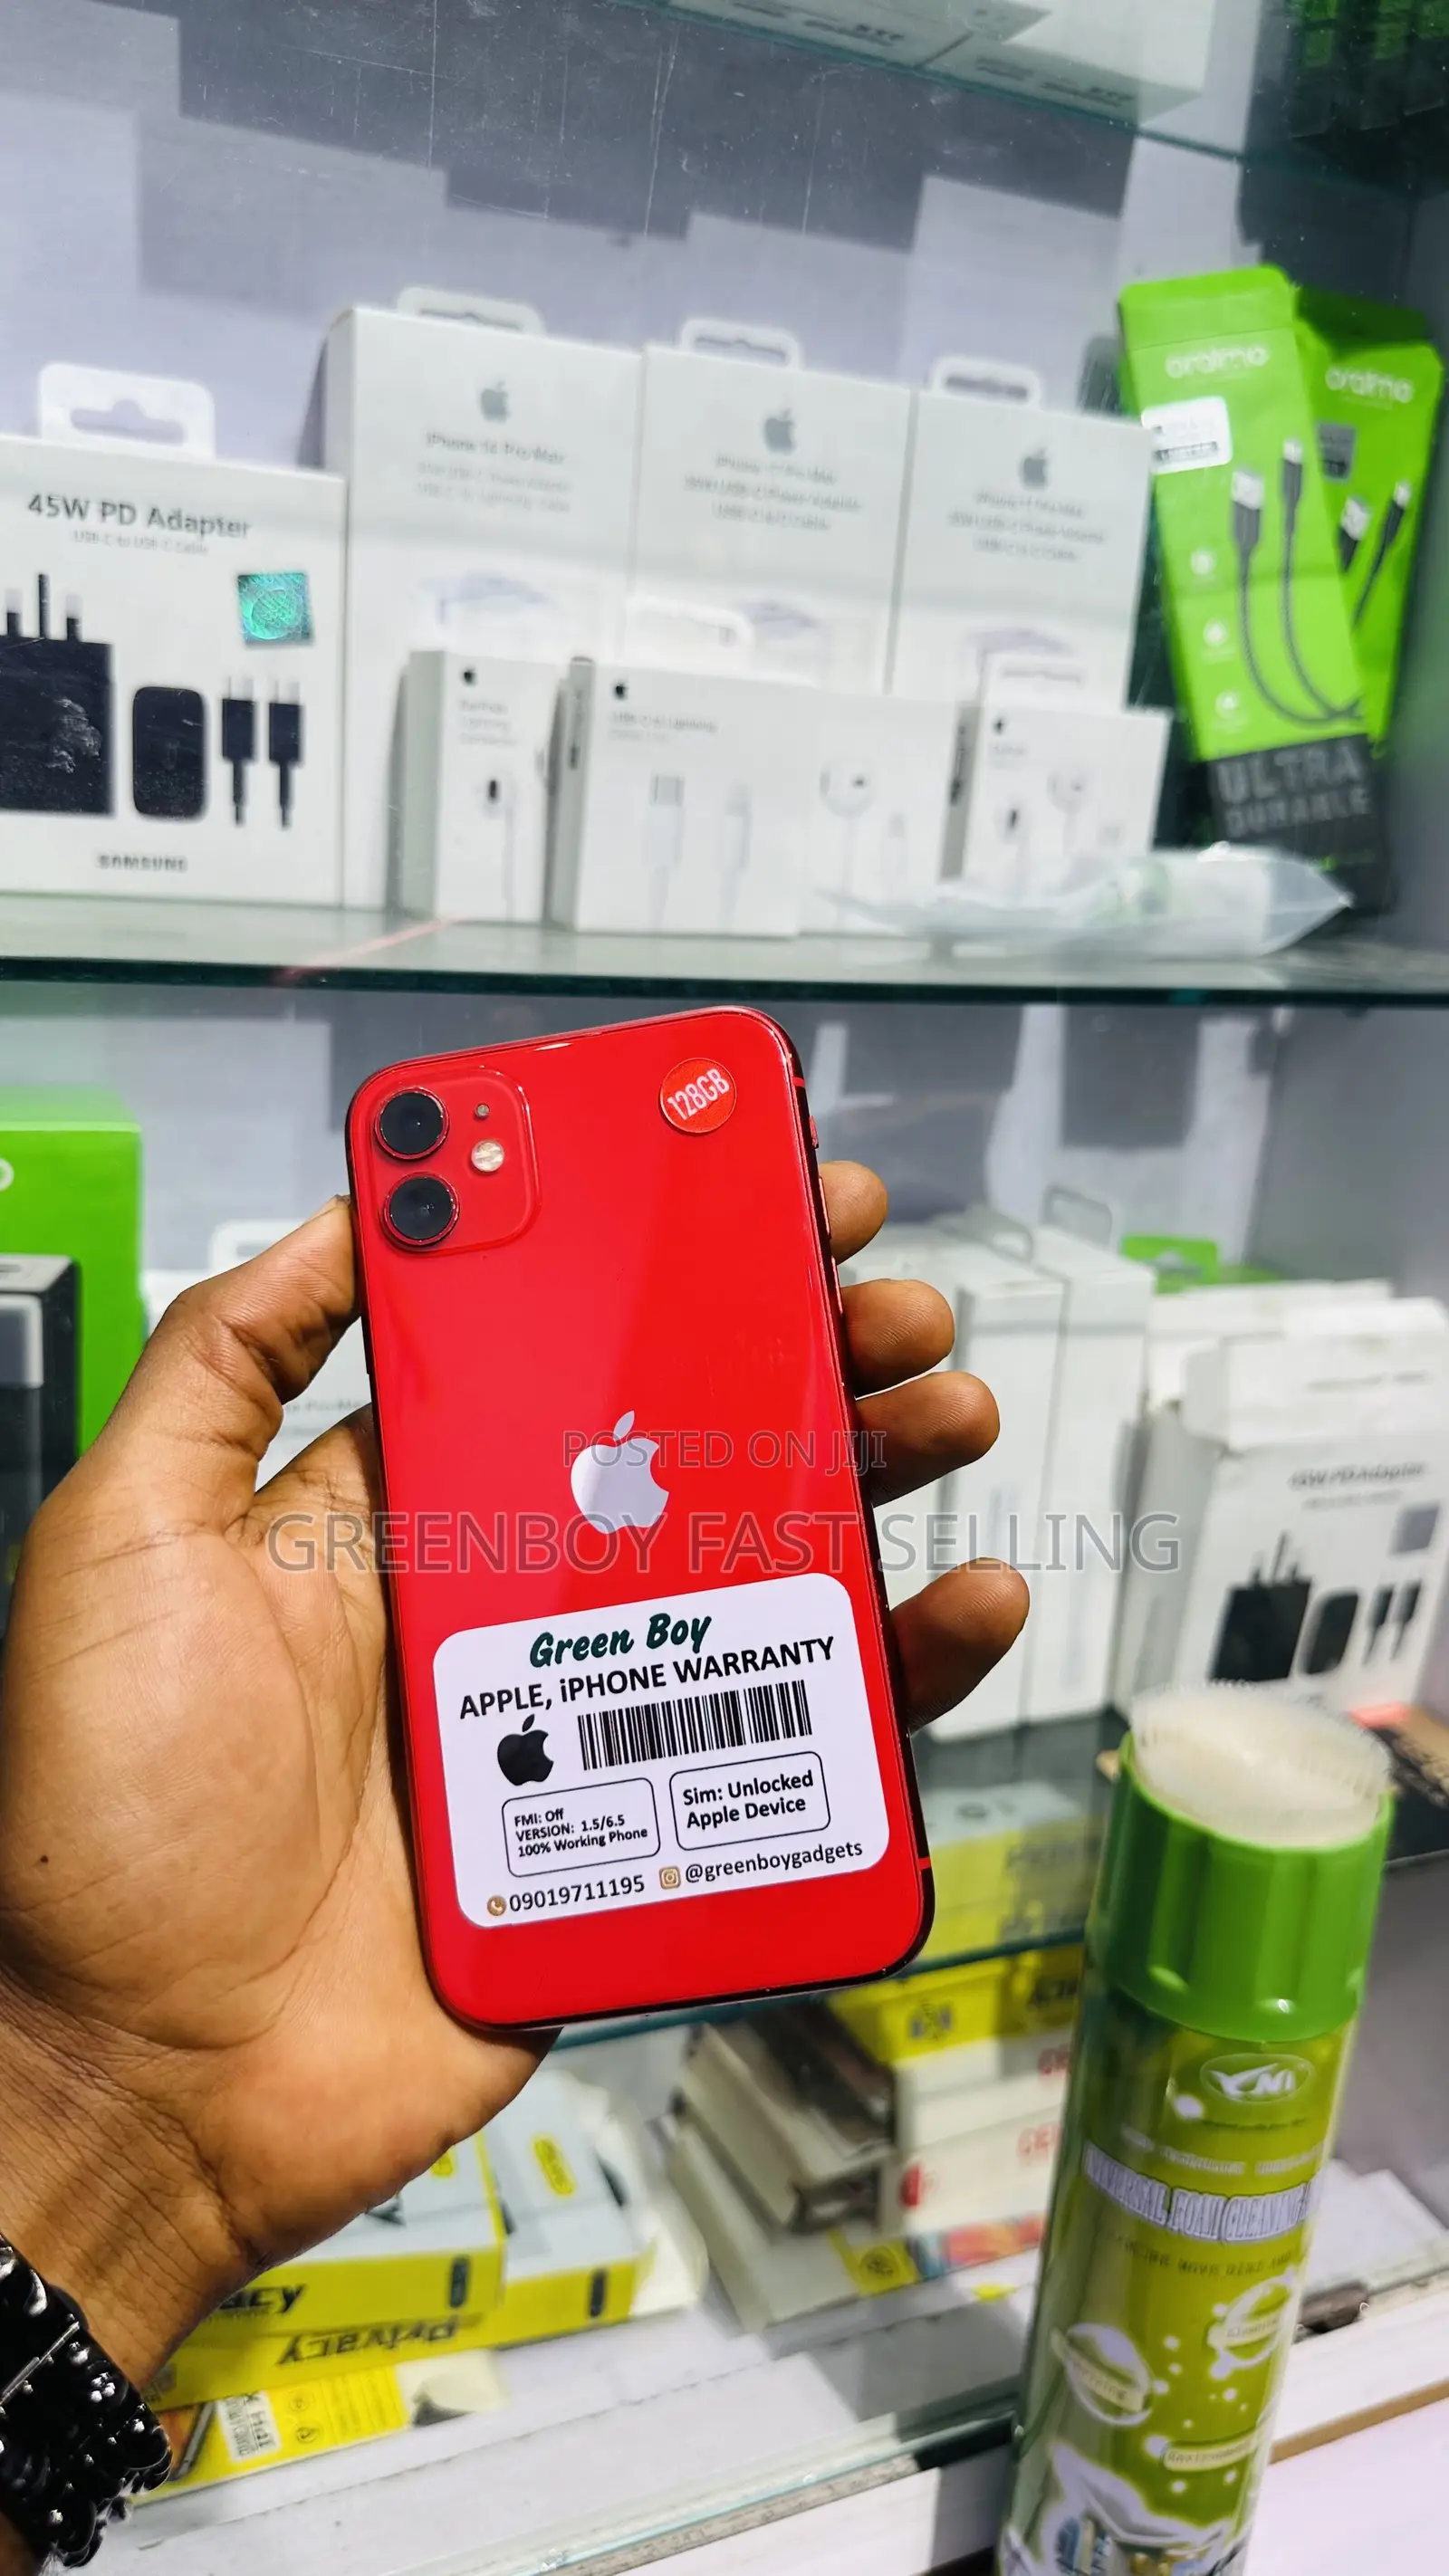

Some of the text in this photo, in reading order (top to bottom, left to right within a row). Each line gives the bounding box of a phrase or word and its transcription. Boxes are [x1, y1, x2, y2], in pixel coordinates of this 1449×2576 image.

[1166, 344, 1269, 378] oraimo
[1325, 366, 1414, 404] oraimo
[28, 493, 252, 541] 45W PD Adapter
[1215, 738, 1362, 803] ULTRA
[1223, 786, 1370, 838] DURABLE
[98, 854, 188, 874] SAMSUNG
[667, 1068, 730, 1121] 128GB
[530, 1612, 713, 1668] Green Boy
[459, 1635, 835, 1719] APPLE, iPHONE WARRANTY
[683, 1768, 814, 1806] Sim: Unlocked
[514, 1807, 565, 1828] FMI: Off
[515, 1814, 626, 1843] VERSION: 1.5/6.5
[686, 1796, 806, 1831] Apple Device
[518, 1827, 648, 1858] 100% Working Phone
[685, 1841, 863, 1884] @greenboygadgets
[509, 1874, 646, 1913] 09019711195
